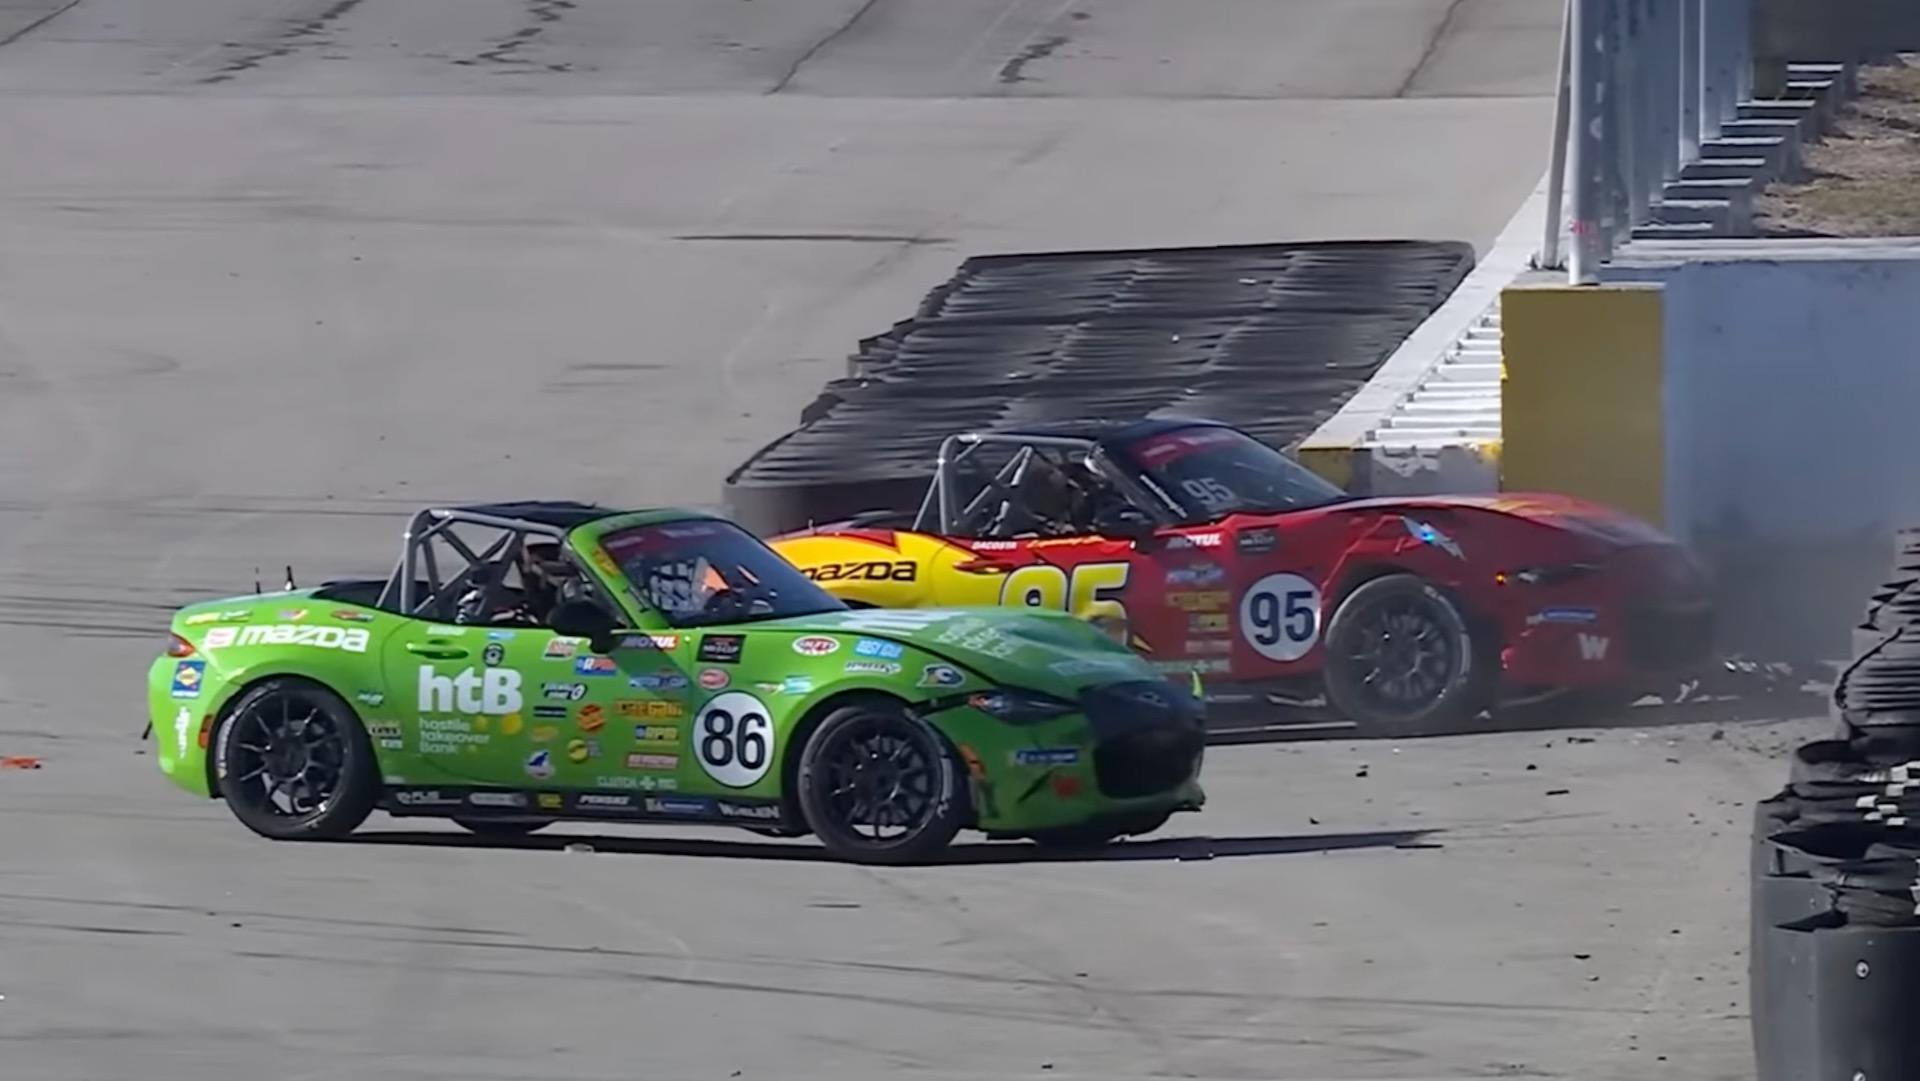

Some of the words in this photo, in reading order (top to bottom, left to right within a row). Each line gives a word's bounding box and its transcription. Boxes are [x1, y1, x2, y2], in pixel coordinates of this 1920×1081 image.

[1182, 478, 1235, 505] 95
[1167, 533, 1222, 549] MOTUL
[1249, 590, 1316, 647] 95
[621, 636, 677, 649] MOTUL
[418, 664, 524, 716] htB
[419, 716, 471, 731] hostile
[420, 730, 490, 744] takeover
[701, 708, 767, 770] 86
